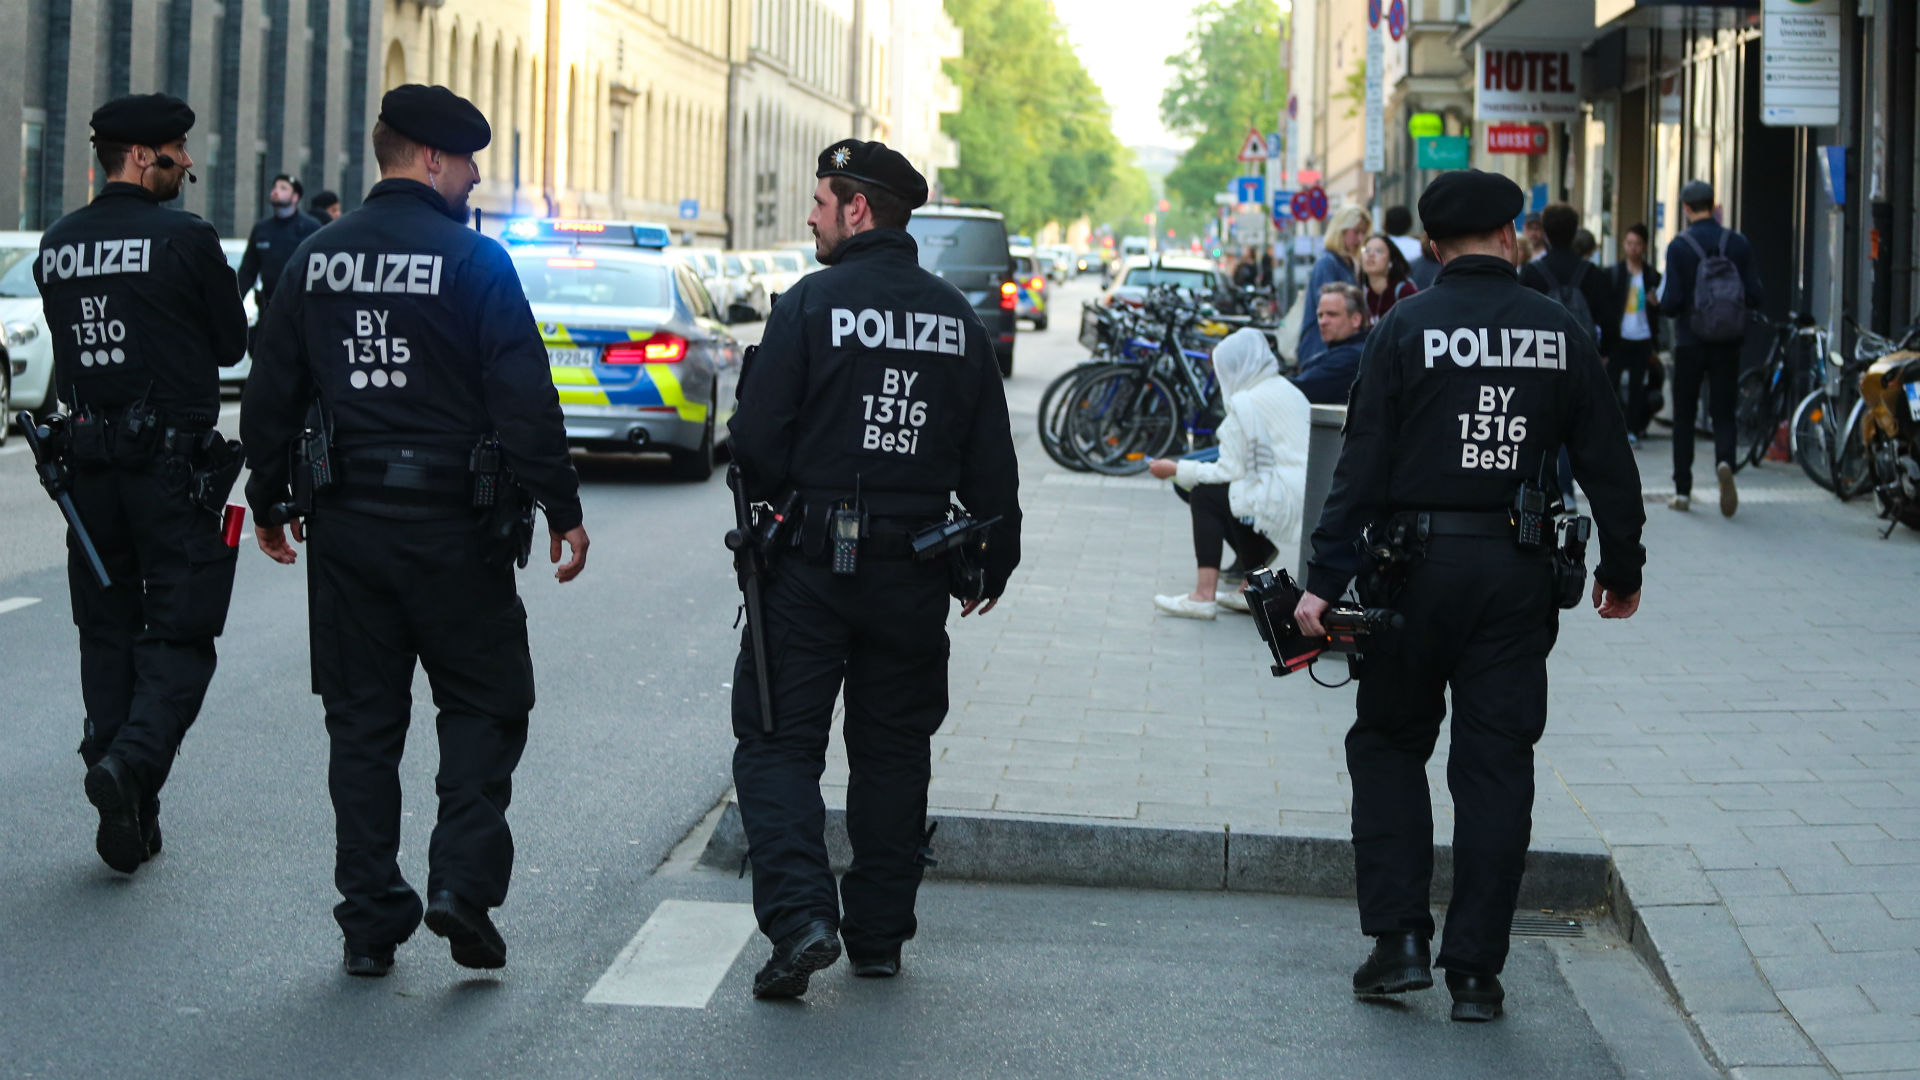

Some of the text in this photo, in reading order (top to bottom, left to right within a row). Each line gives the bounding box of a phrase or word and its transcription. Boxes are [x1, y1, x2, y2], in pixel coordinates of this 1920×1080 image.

[1485, 50, 1575, 93] HOTEL
[42, 238, 151, 284] POLIZEI
[306, 252, 443, 295] POLIZEI
[80, 295, 108, 320] BY
[71, 319, 126, 346] 1310
[356, 309, 389, 337] BY
[831, 308, 966, 357] POLIZEI
[342, 337, 411, 364] 1315
[1423, 327, 1567, 371] POLIZEI
[882, 367, 919, 397] BY
[862, 395, 929, 427] 1316
[1478, 385, 1516, 414] BY
[862, 424, 919, 455] BeSi
[1457, 413, 1528, 443] 1316
[1461, 443, 1519, 471] BeSi
